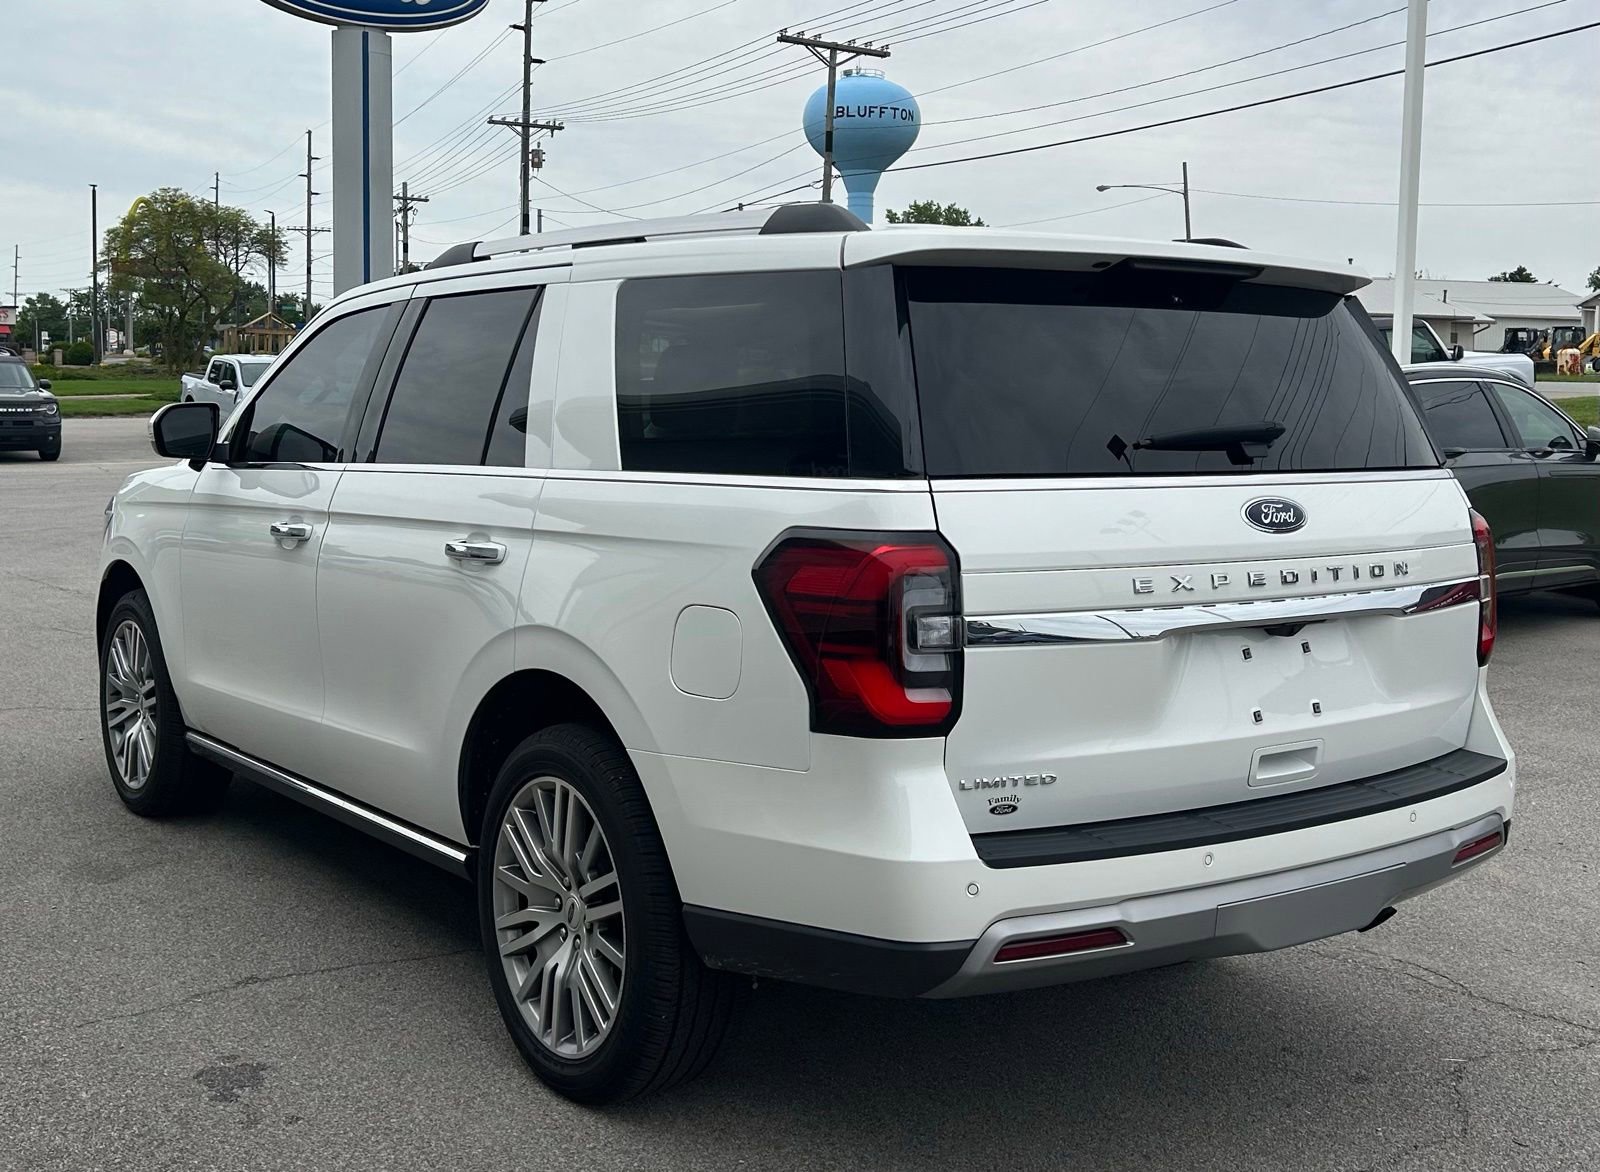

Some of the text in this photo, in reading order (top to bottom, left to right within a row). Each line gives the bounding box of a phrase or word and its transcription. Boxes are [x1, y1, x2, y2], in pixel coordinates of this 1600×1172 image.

[835, 105, 914, 122] BLUFFTON
[1260, 503, 1296, 525] Ford
[1132, 561, 1409, 594] EXPEDITION
[959, 773, 1058, 791] LIMITED
[987, 794, 1022, 806] Family
[994, 805, 1014, 814] Ford
